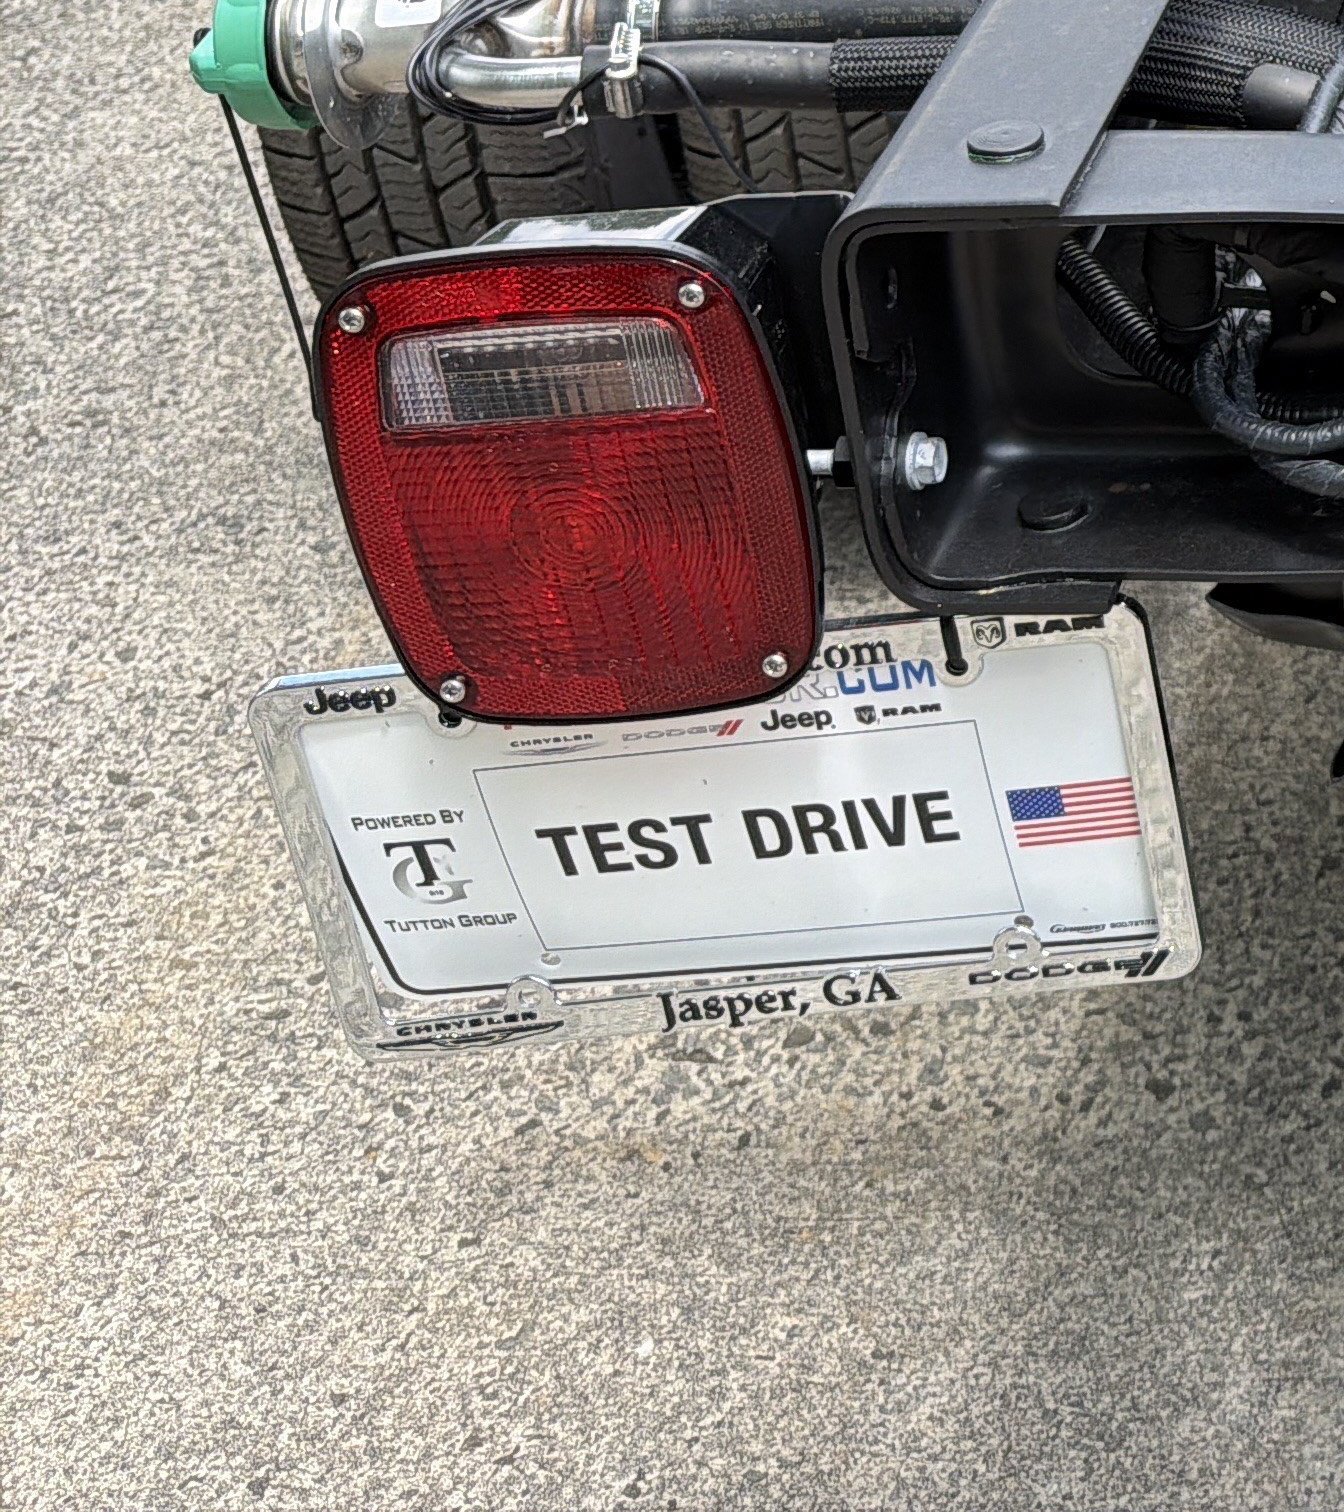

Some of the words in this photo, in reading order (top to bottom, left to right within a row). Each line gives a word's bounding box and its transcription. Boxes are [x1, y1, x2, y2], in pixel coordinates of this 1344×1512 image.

[1015, 615, 1105, 638] RAM
[303, 685, 397, 716] Jeep
[882, 702, 942, 718] RAM
[760, 707, 833, 733] Jeep
[509, 733, 595, 749] CHRYSLER
[535, 813, 713, 877] TEST
[741, 790, 961, 860] DRIVE
[968, 951, 1147, 986] DODGE
[655, 984, 811, 1034] Jasper,
[822, 970, 903, 1008] GA
[396, 1010, 539, 1038] CHRYSLER
